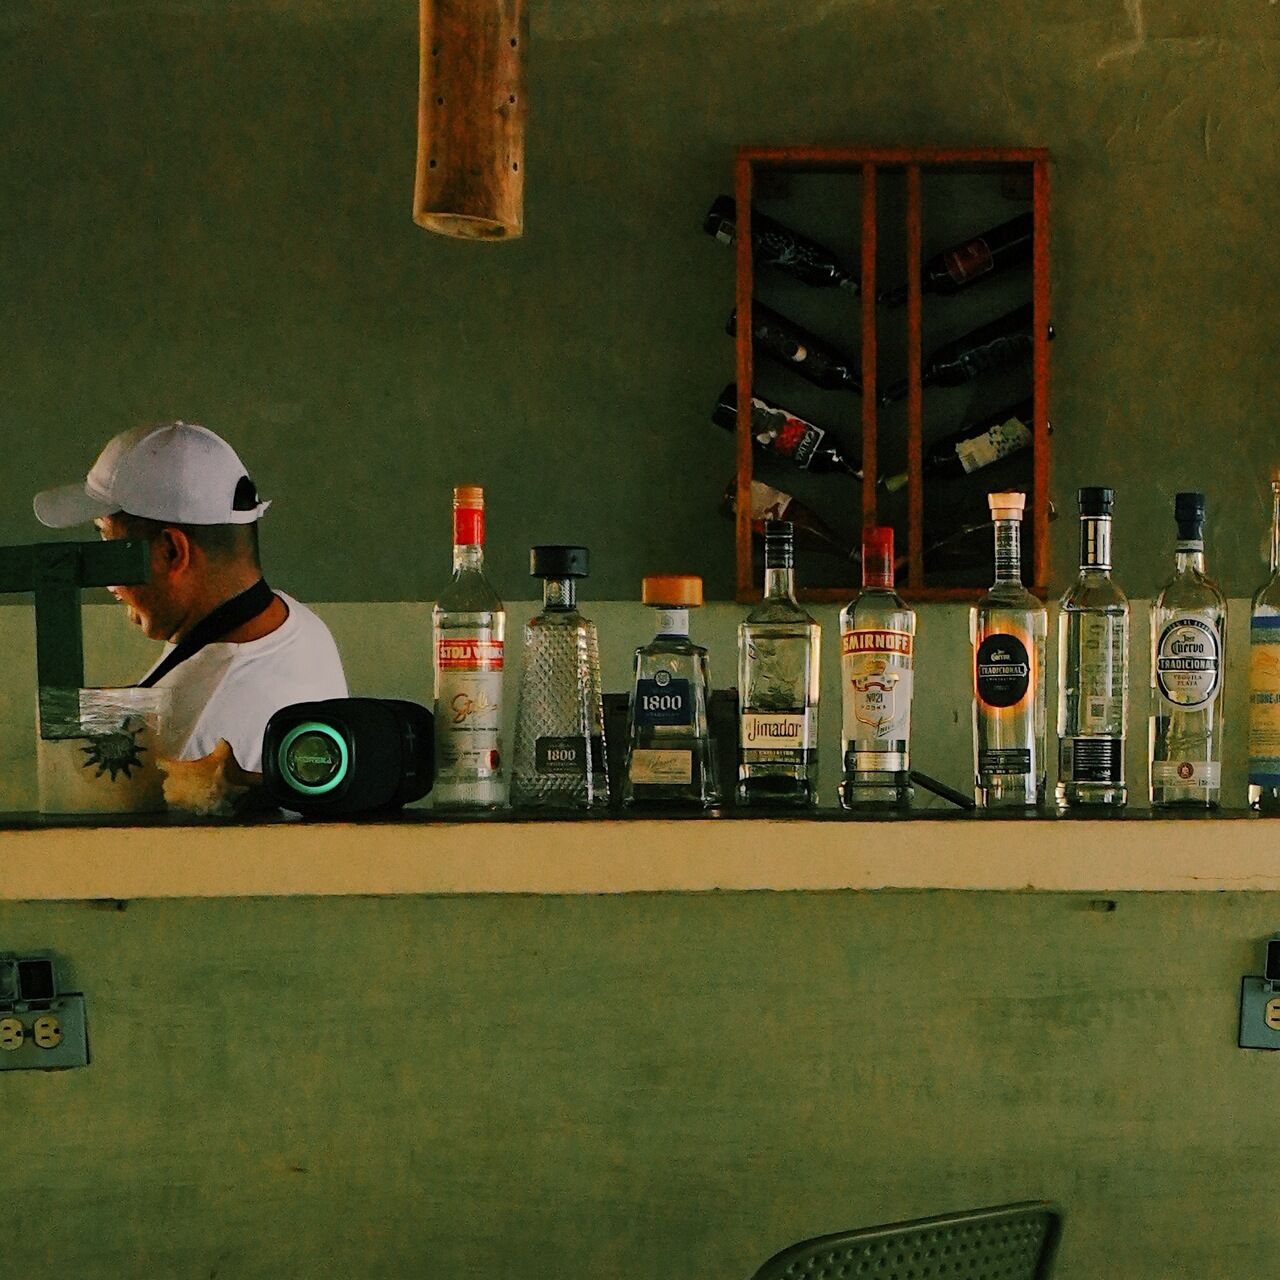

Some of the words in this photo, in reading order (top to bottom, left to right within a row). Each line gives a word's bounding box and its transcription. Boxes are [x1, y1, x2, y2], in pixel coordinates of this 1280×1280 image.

[843, 634, 908, 651] SMIRNOFF
[1171, 640, 1204, 655] Cuervo
[440, 646, 471, 659] STOLI
[981, 666, 1023, 674] TRADICIONAL
[1160, 659, 1217, 670] TRADICIONAL
[642, 695, 682, 711] 1800
[748, 718, 801, 741] Jimador
[547, 749, 576, 761] 1800
